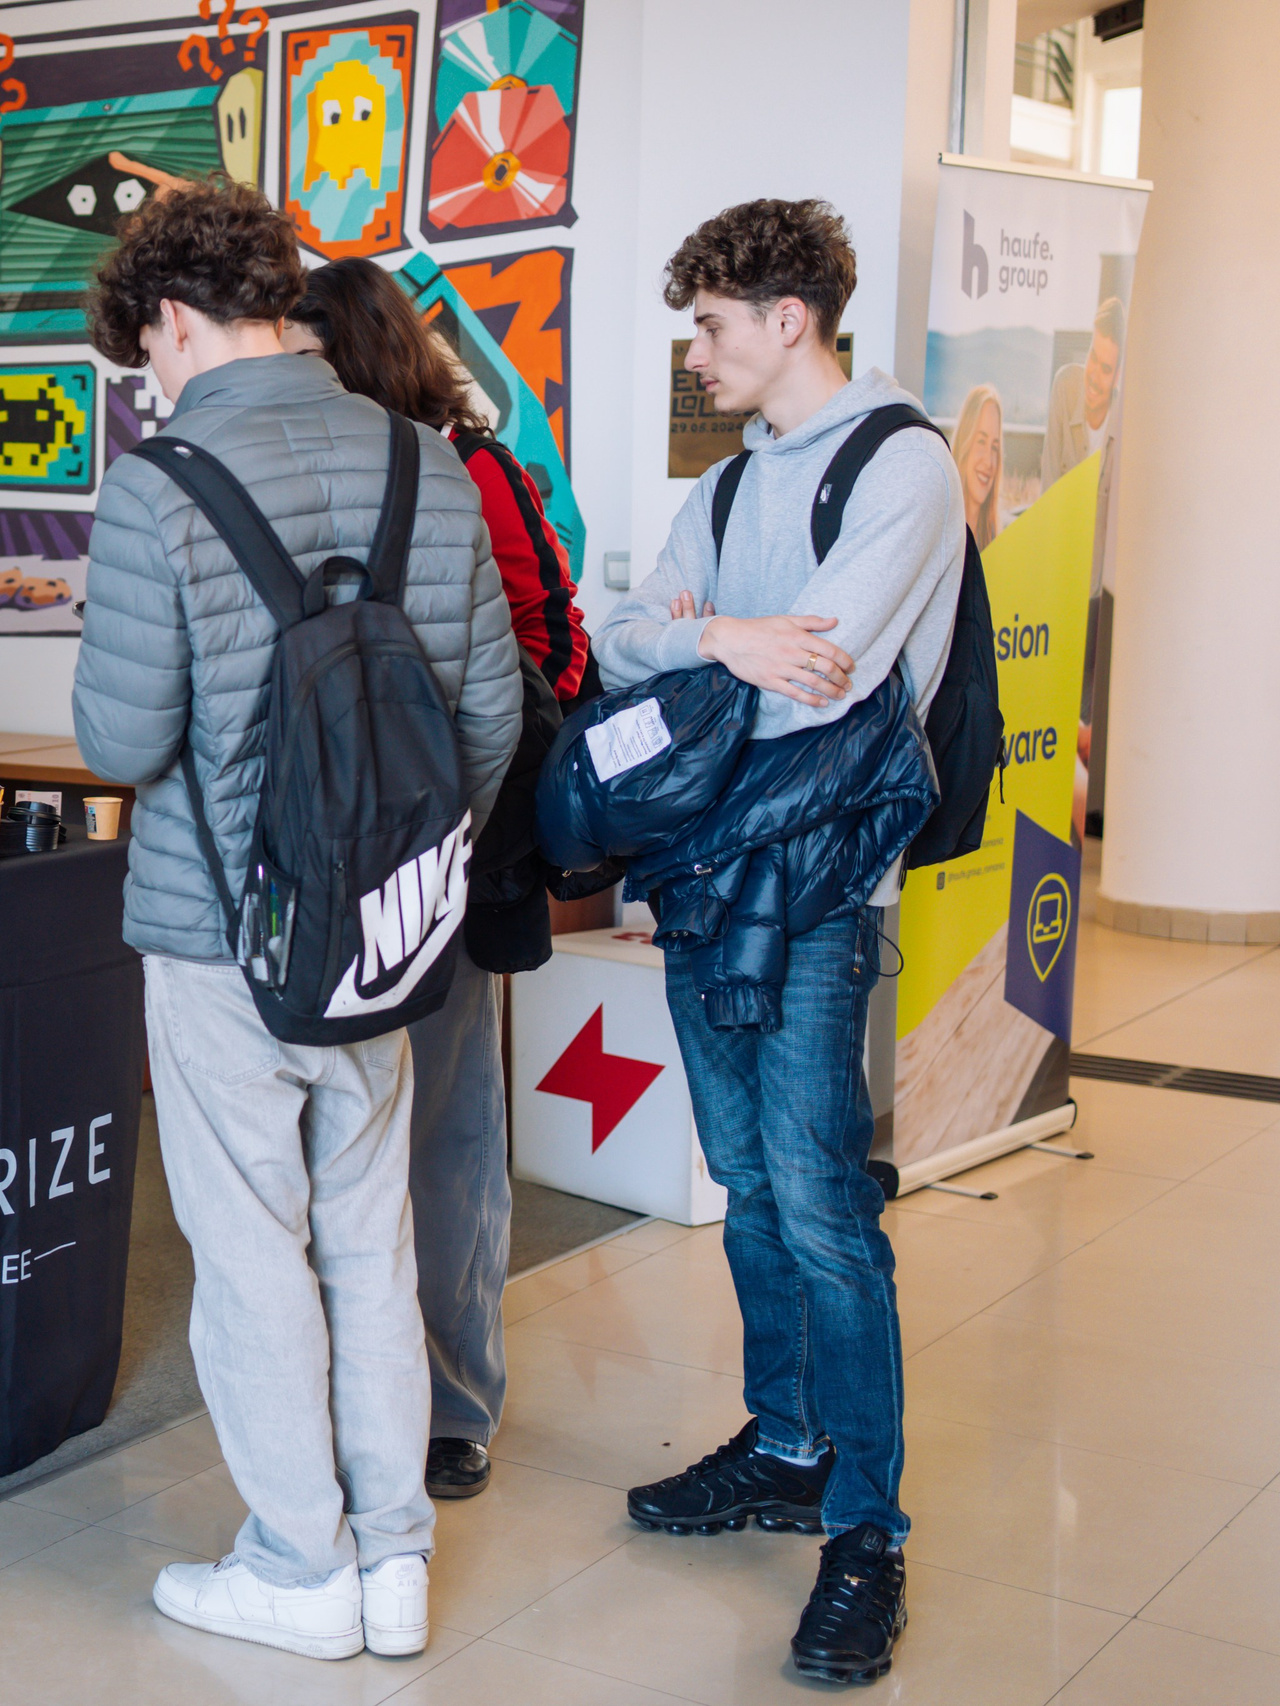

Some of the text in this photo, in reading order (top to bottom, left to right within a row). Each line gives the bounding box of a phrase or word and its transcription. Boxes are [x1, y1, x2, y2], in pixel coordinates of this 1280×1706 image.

[1000, 228, 1053, 260] haufe.
[998, 265, 1048, 296] group
[993, 613, 1049, 662] sion
[359, 808, 472, 987] NIKE
